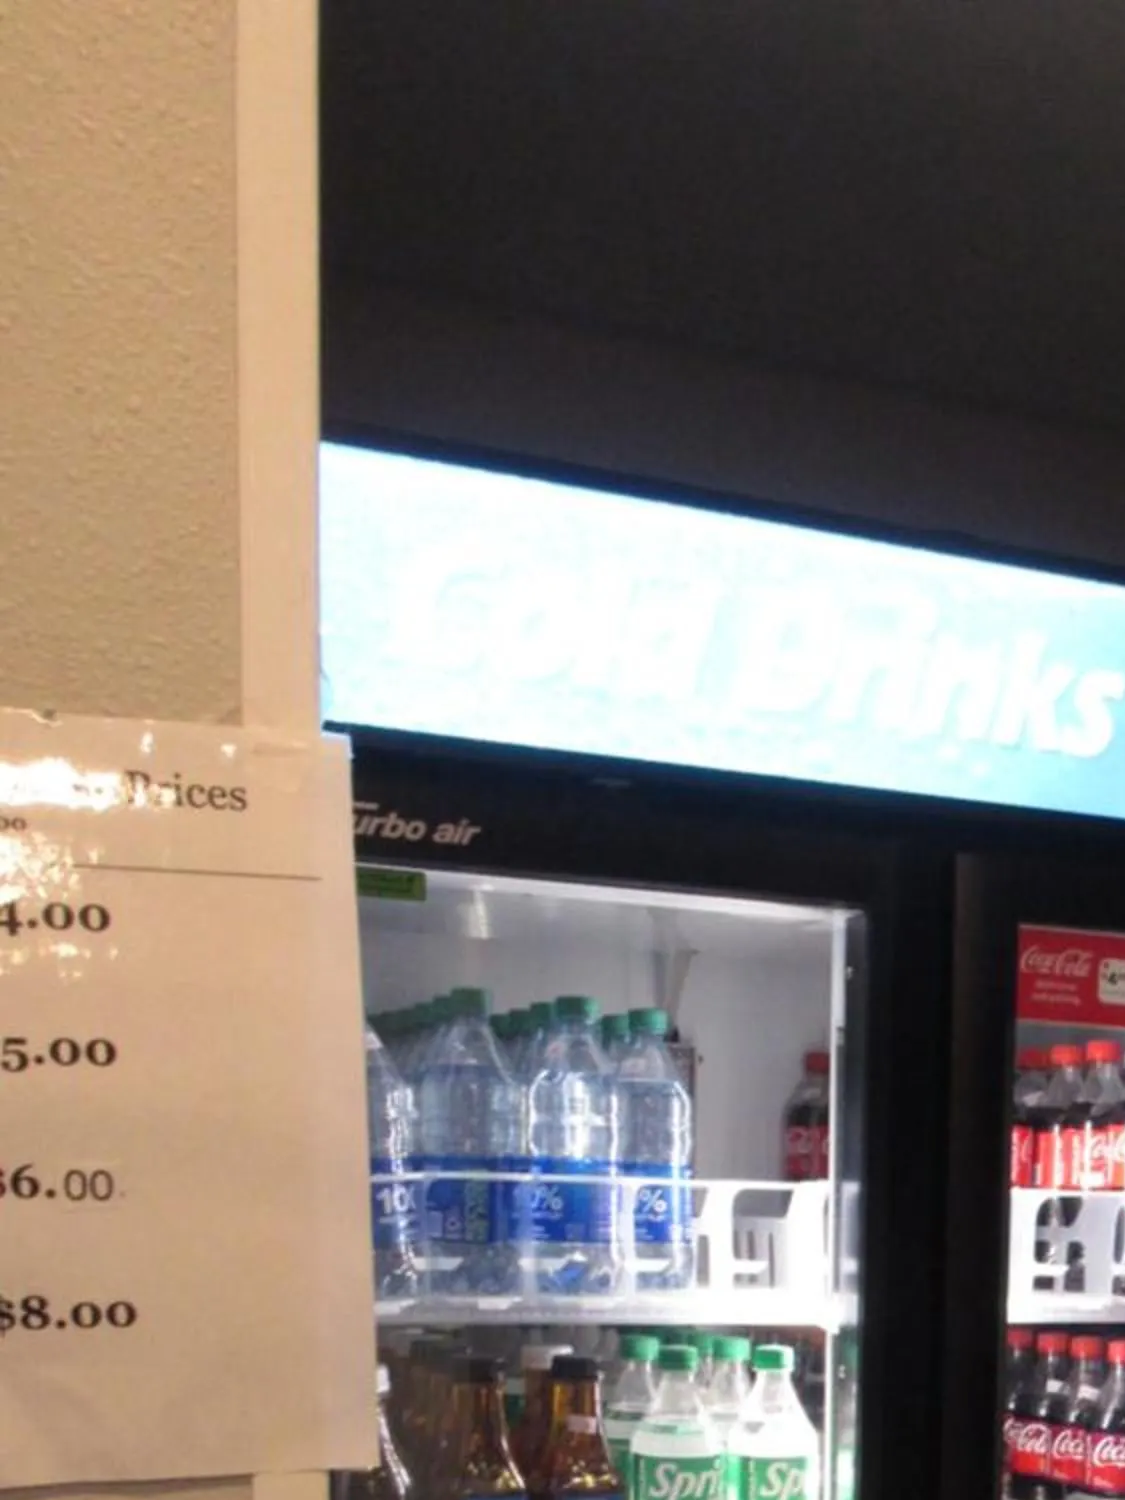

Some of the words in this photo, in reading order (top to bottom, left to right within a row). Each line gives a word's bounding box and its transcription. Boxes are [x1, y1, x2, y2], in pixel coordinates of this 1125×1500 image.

[386, 534, 724, 702] Cold
[727, 583, 1124, 758] Drinks
[124, 770, 248, 812] Prices
[433, 817, 482, 845] air
